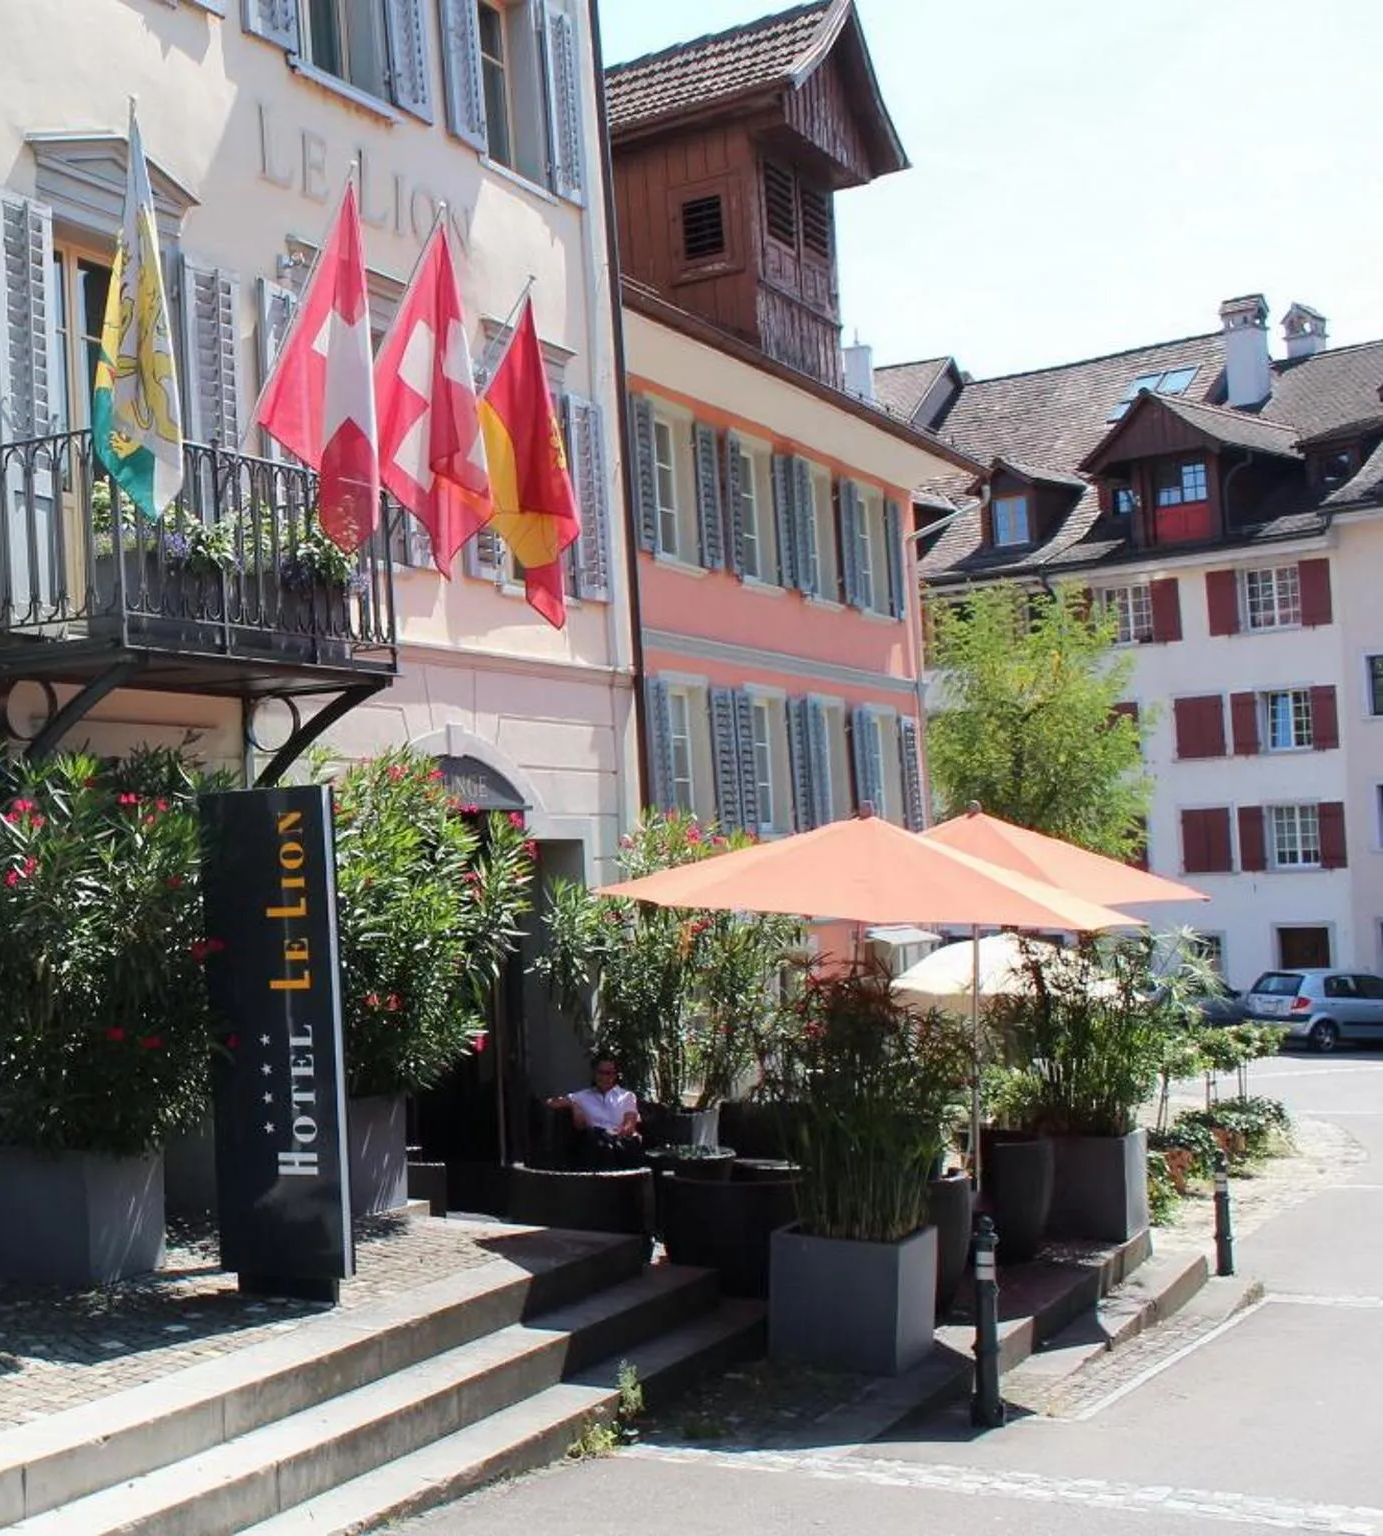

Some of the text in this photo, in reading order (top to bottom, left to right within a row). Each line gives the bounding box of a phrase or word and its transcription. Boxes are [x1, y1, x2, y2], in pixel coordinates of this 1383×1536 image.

[256, 103, 473, 260] LE LION
[269, 937, 312, 990] LE
[277, 1024, 320, 1175] HOTEL
